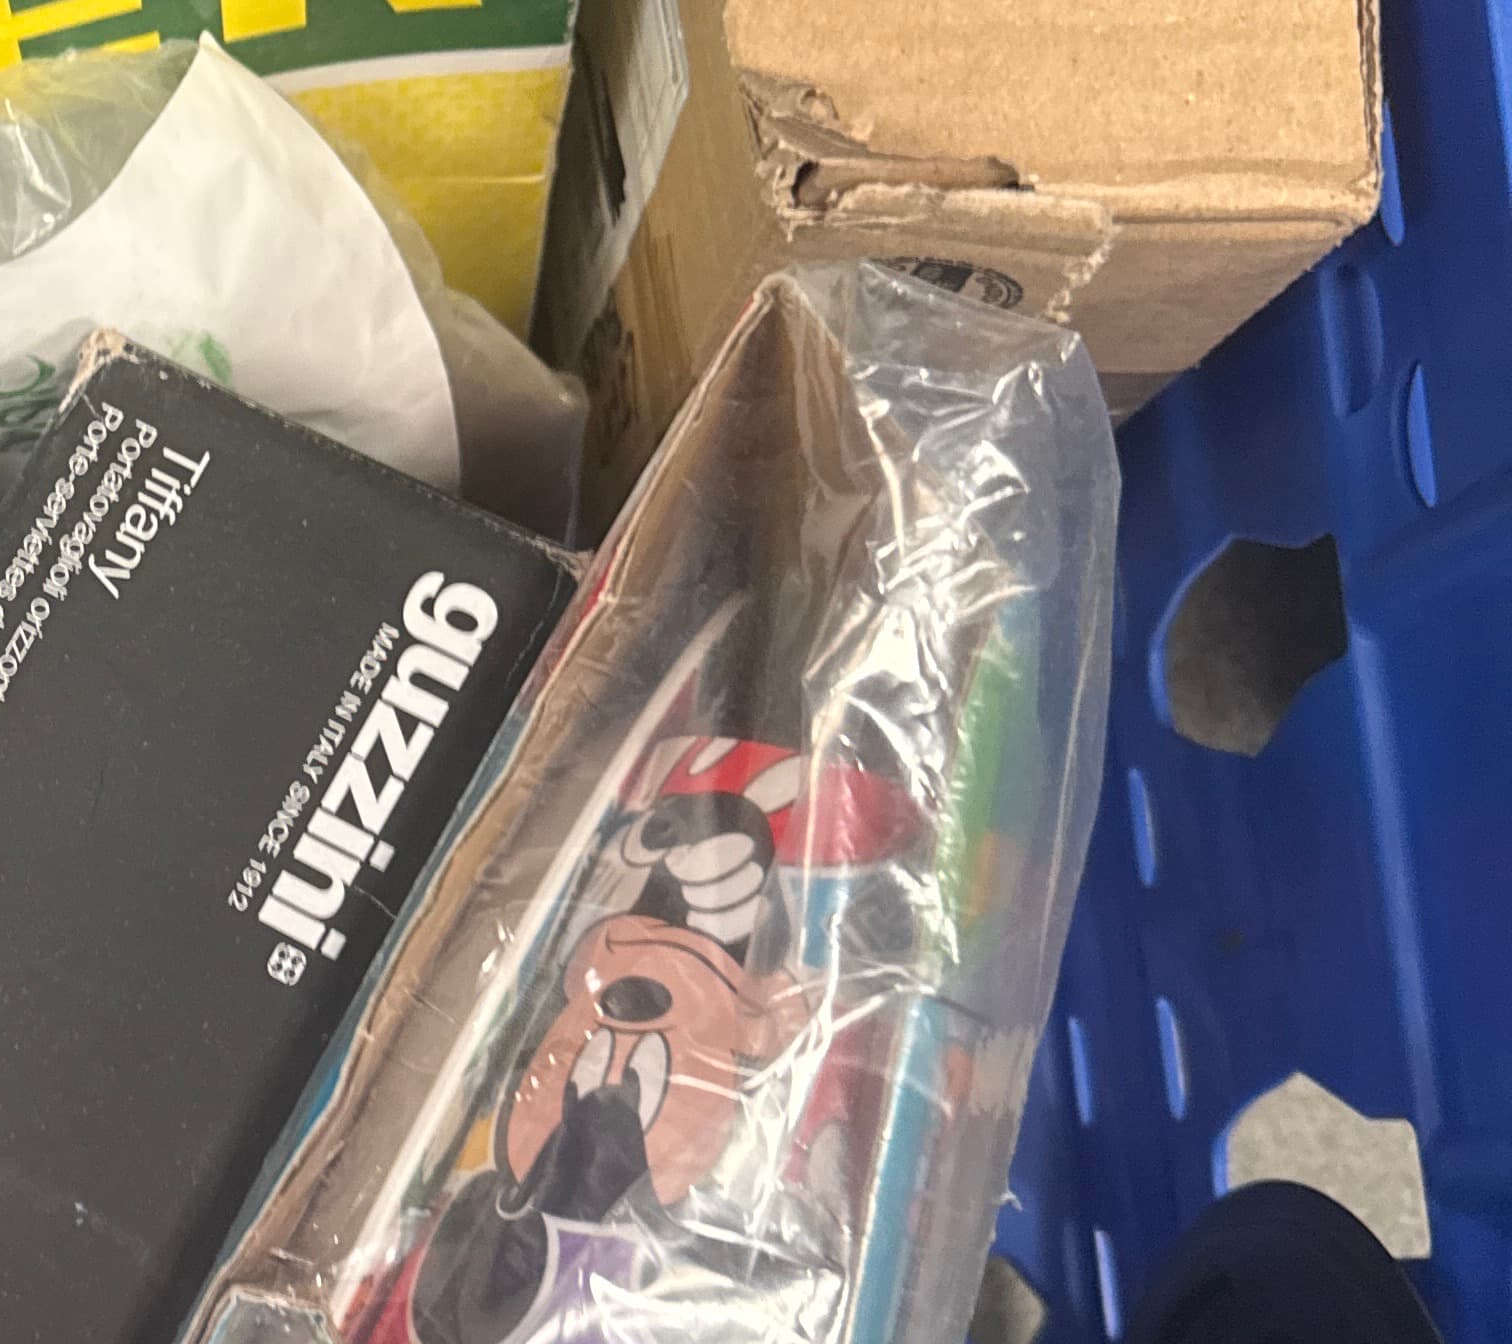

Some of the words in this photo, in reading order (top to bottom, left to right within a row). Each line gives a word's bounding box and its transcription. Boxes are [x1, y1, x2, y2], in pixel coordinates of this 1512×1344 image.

[43, 419, 157, 601] Portatovaglioli
[88, 447, 210, 599] Tiffany
[350, 623, 399, 694] MADE
[335, 691, 361, 721] IN
[259, 572, 498, 959] guzzini
[303, 719, 345, 784] ITALY
[259, 781, 310, 858] SINCE
[228, 859, 266, 911] 1912
